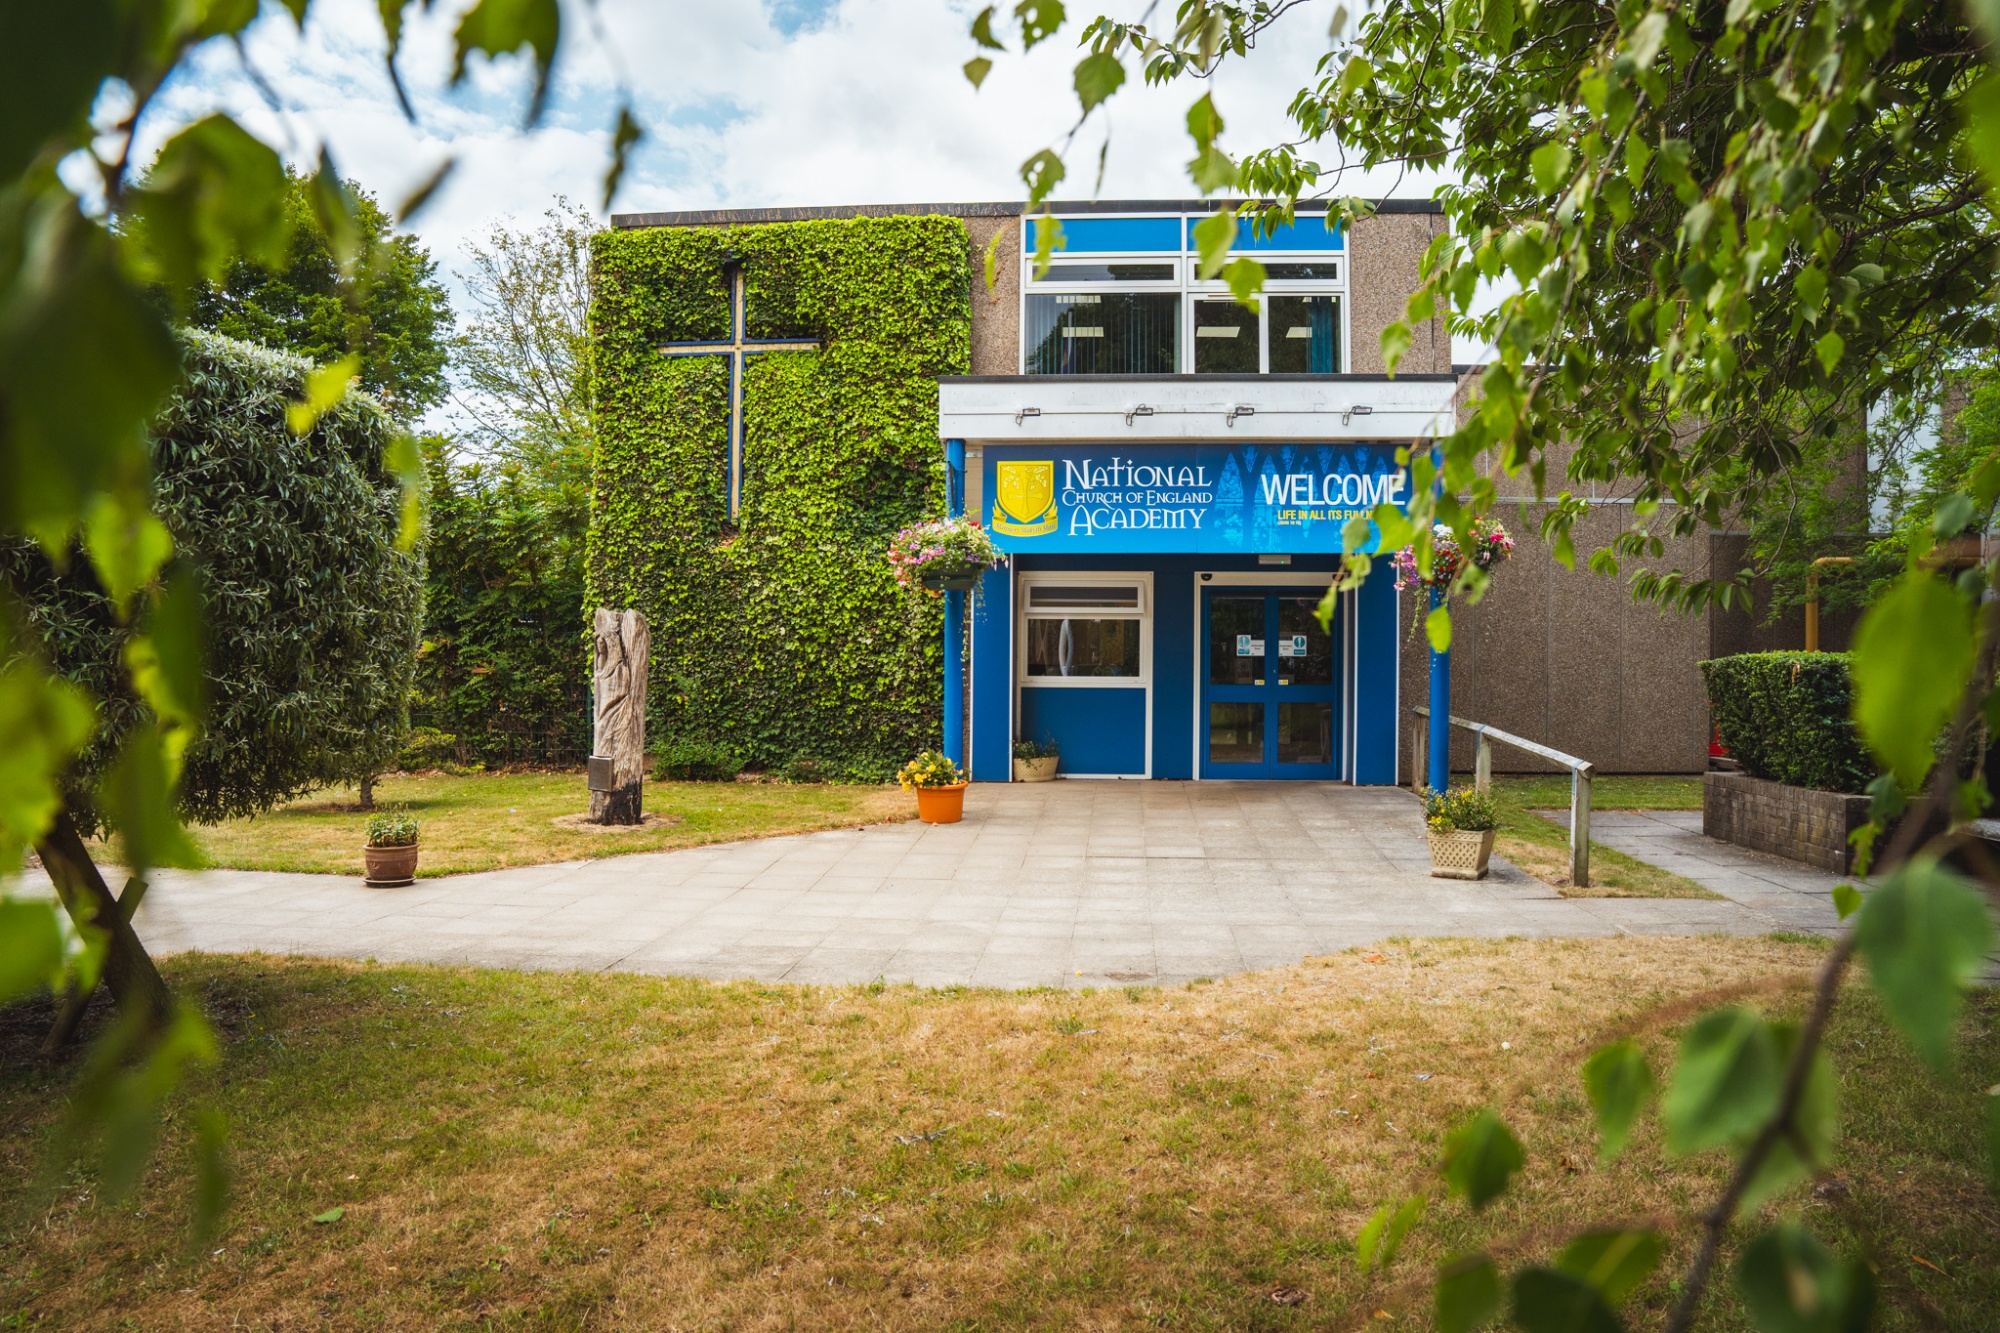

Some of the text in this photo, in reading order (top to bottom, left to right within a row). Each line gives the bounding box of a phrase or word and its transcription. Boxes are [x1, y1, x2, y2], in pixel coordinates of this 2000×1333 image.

[1062, 490, 1123, 510] CHURCH
[1145, 490, 1213, 506] ENGLAND
[1261, 473, 1405, 505] WELCOME
[1067, 505, 1208, 536] ACADEMY
[1277, 510, 1296, 520] LIFE
[1298, 510, 1308, 520] IN
[1309, 510, 1326, 520] ALL
[1328, 510, 1342, 520] ITS
